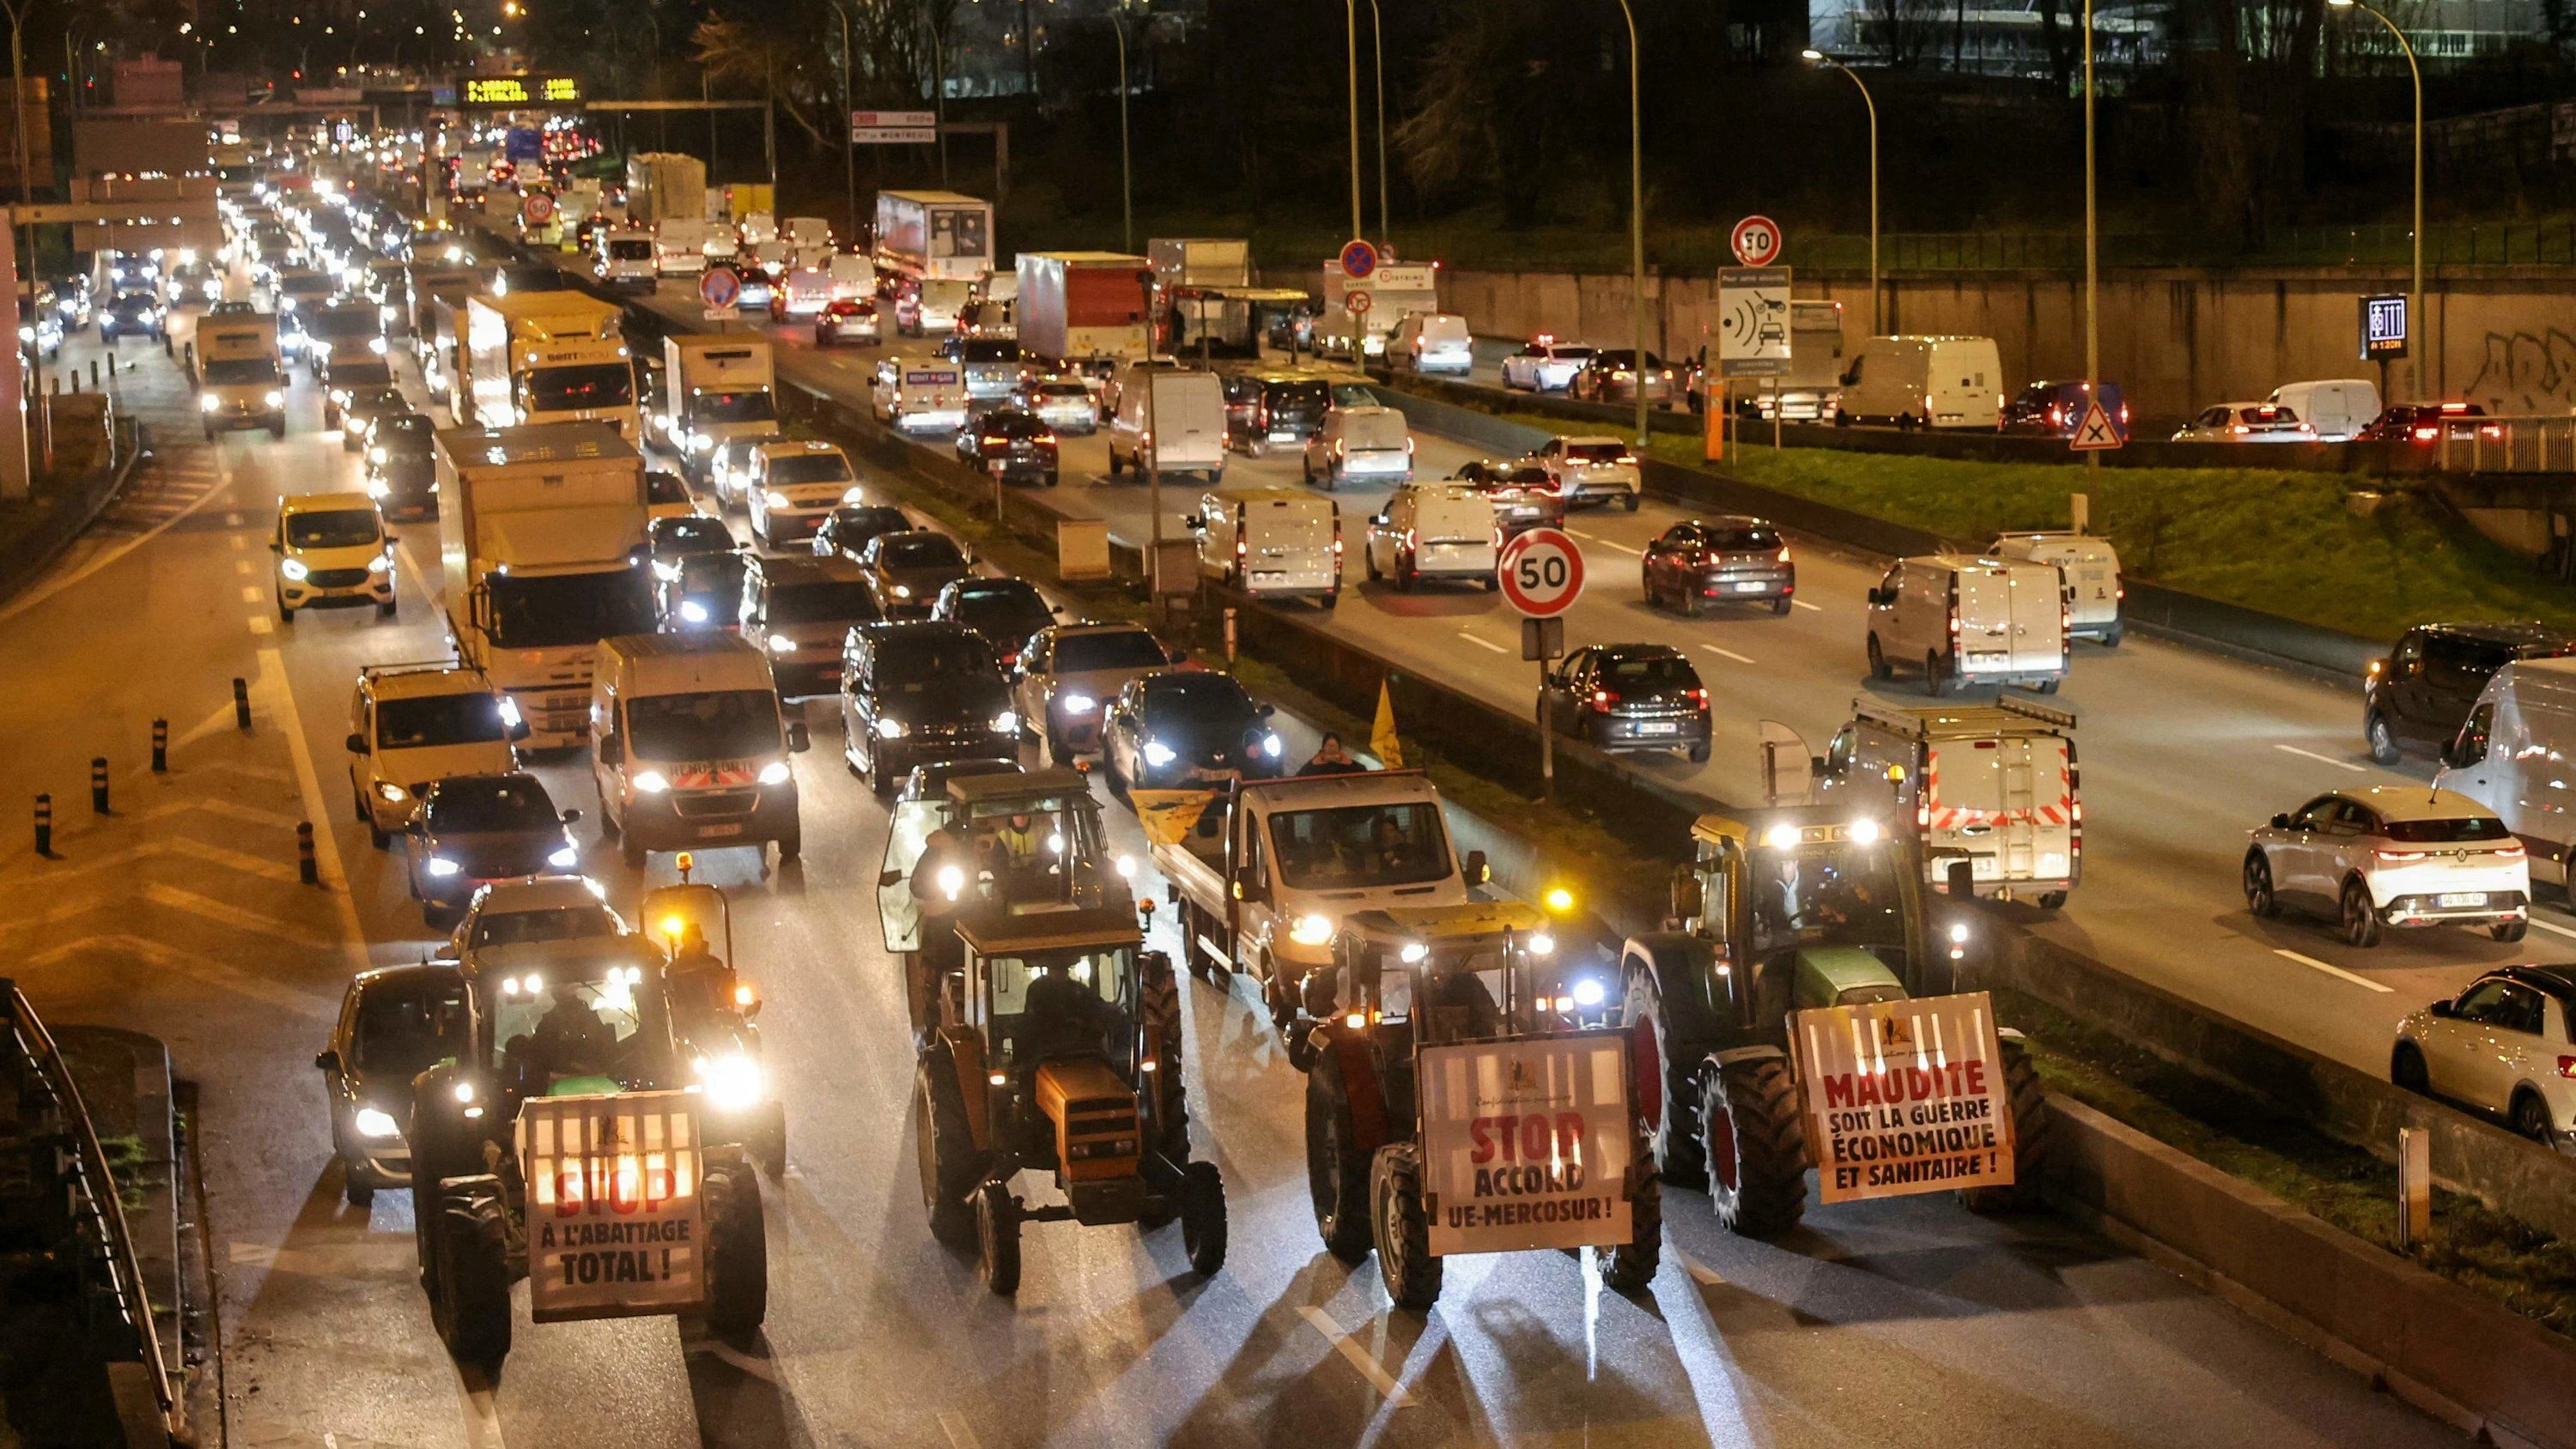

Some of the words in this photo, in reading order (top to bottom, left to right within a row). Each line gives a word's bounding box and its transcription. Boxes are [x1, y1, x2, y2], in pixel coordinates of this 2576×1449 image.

[1520, 555, 1566, 590] 50
[1823, 1059, 1988, 1109] MAUDITE
[1830, 1112, 1872, 1134] SOIT
[1879, 1107, 1905, 1129] LA
[1910, 1098, 1992, 1125] GUERRE
[1470, 1112, 1585, 1163] STOP
[1832, 1123, 1997, 1163] ÉCONOMIQUE
[1473, 1162, 1585, 1197] ACCORD
[1836, 1167, 1861, 1190] ET
[1868, 1155, 1982, 1186] SANITAIRE
[555, 1167, 677, 1218] STOP
[1449, 1197, 1601, 1228] UE-MERCOSUR
[541, 1222, 556, 1248] À
[563, 1219, 691, 1247] L'ABATTAGE
[560, 1250, 656, 1285] TOTAL
[661, 1248, 671, 1281] !
